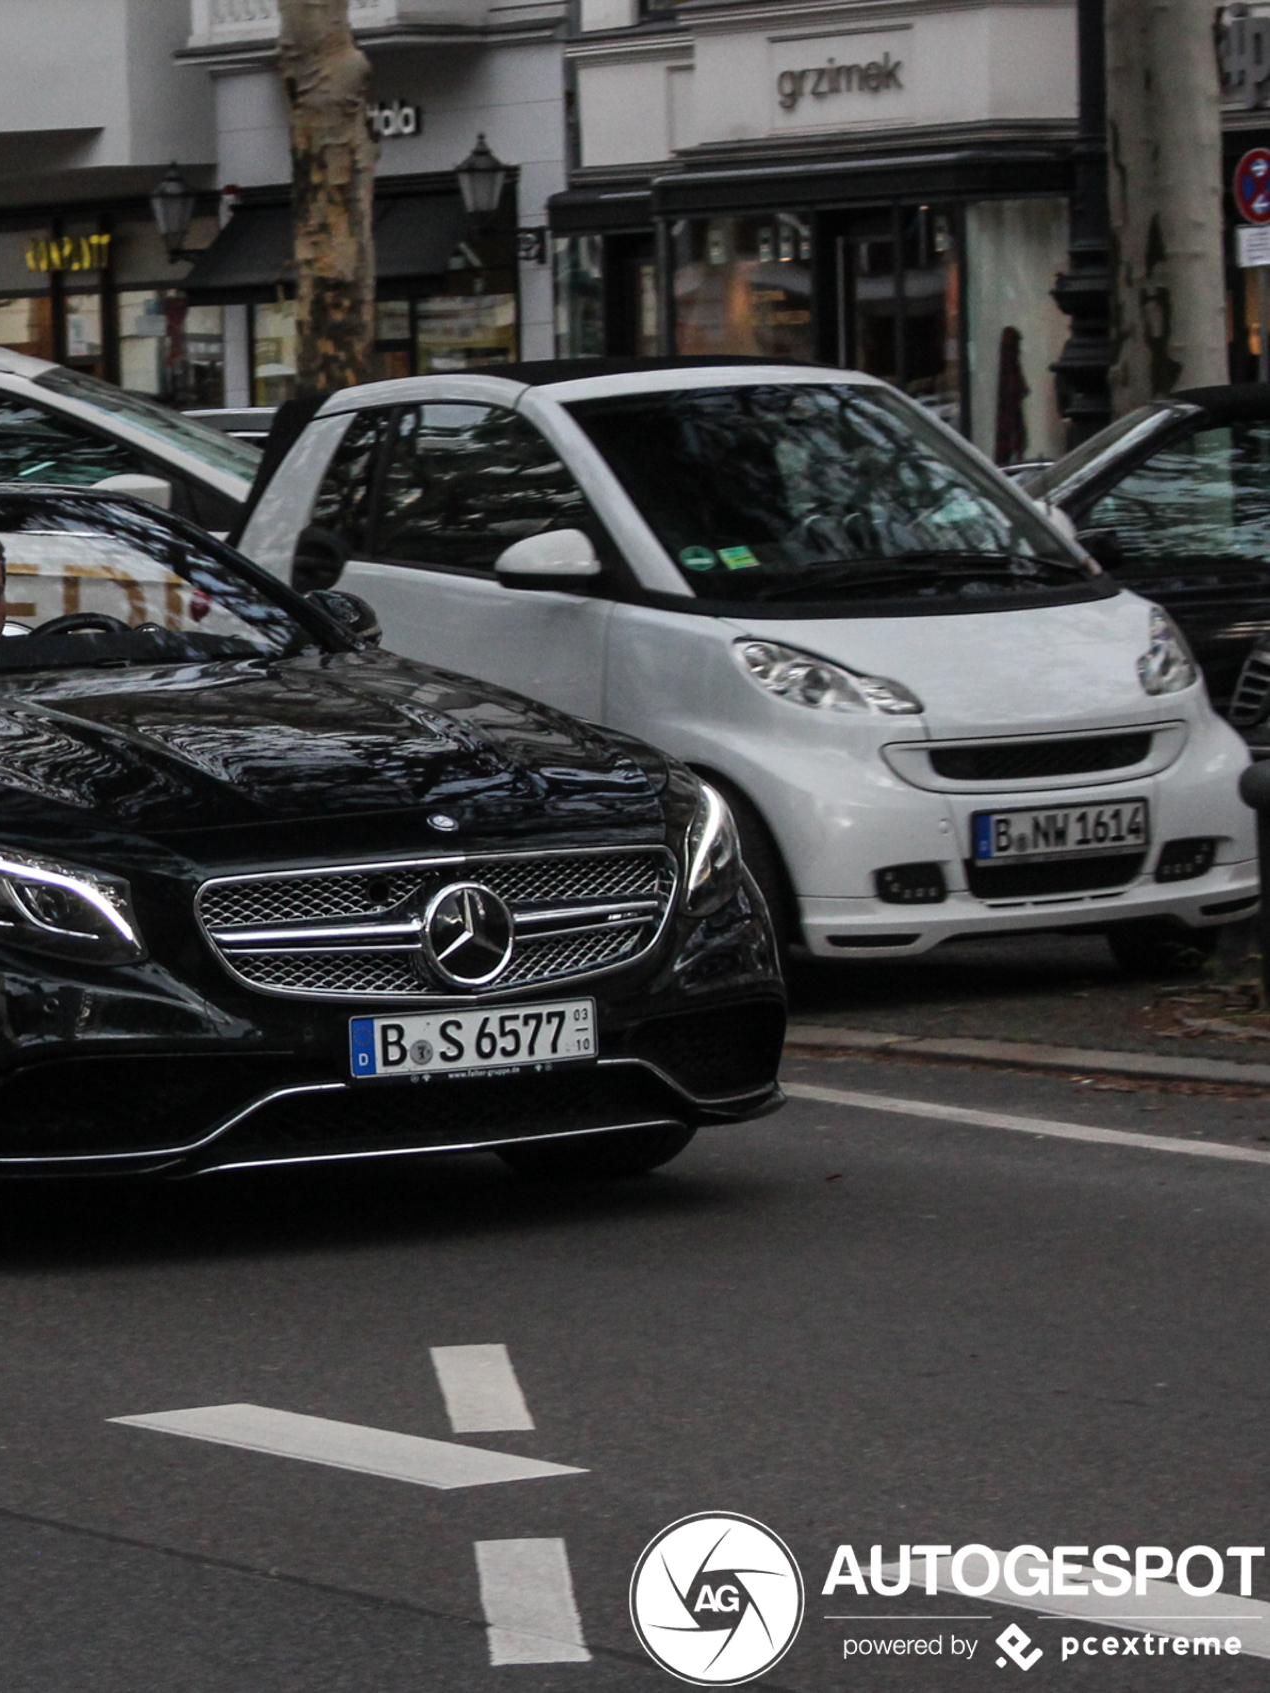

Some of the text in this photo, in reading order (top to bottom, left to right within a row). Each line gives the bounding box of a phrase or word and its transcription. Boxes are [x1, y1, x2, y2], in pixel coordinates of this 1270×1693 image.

[777, 51, 904, 113] grzimek
[994, 807, 1143, 852] B NW 1614
[573, 1007, 590, 1022] 03
[380, 1010, 567, 1067] B S 6577
[575, 1037, 591, 1051] 10
[358, 1053, 370, 1067] D
